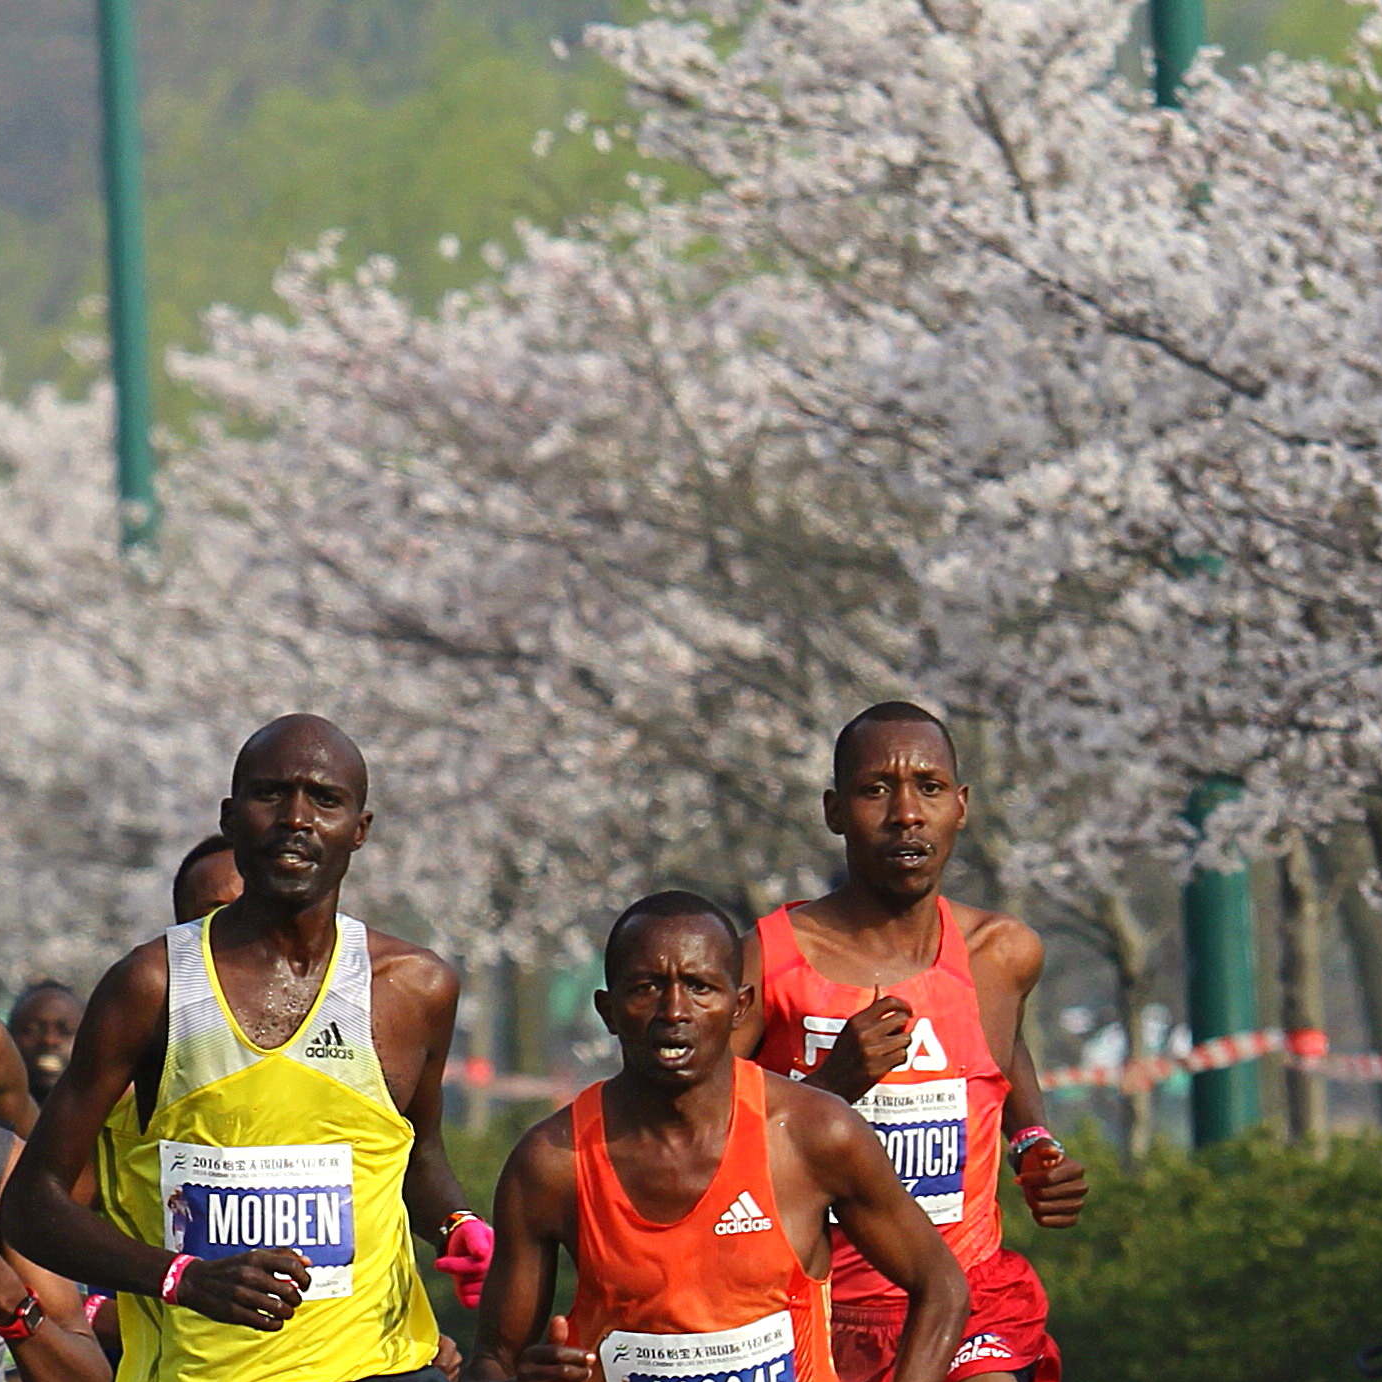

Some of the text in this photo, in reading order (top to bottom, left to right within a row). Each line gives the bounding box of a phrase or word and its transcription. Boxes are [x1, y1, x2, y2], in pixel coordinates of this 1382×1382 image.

[305, 1045, 355, 1060] adidas
[803, 1015, 949, 1073] FA
[875, 1125, 959, 1178] OTICH
[208, 1192, 341, 1247] MOIBEN
[714, 1217, 773, 1235] adidas
